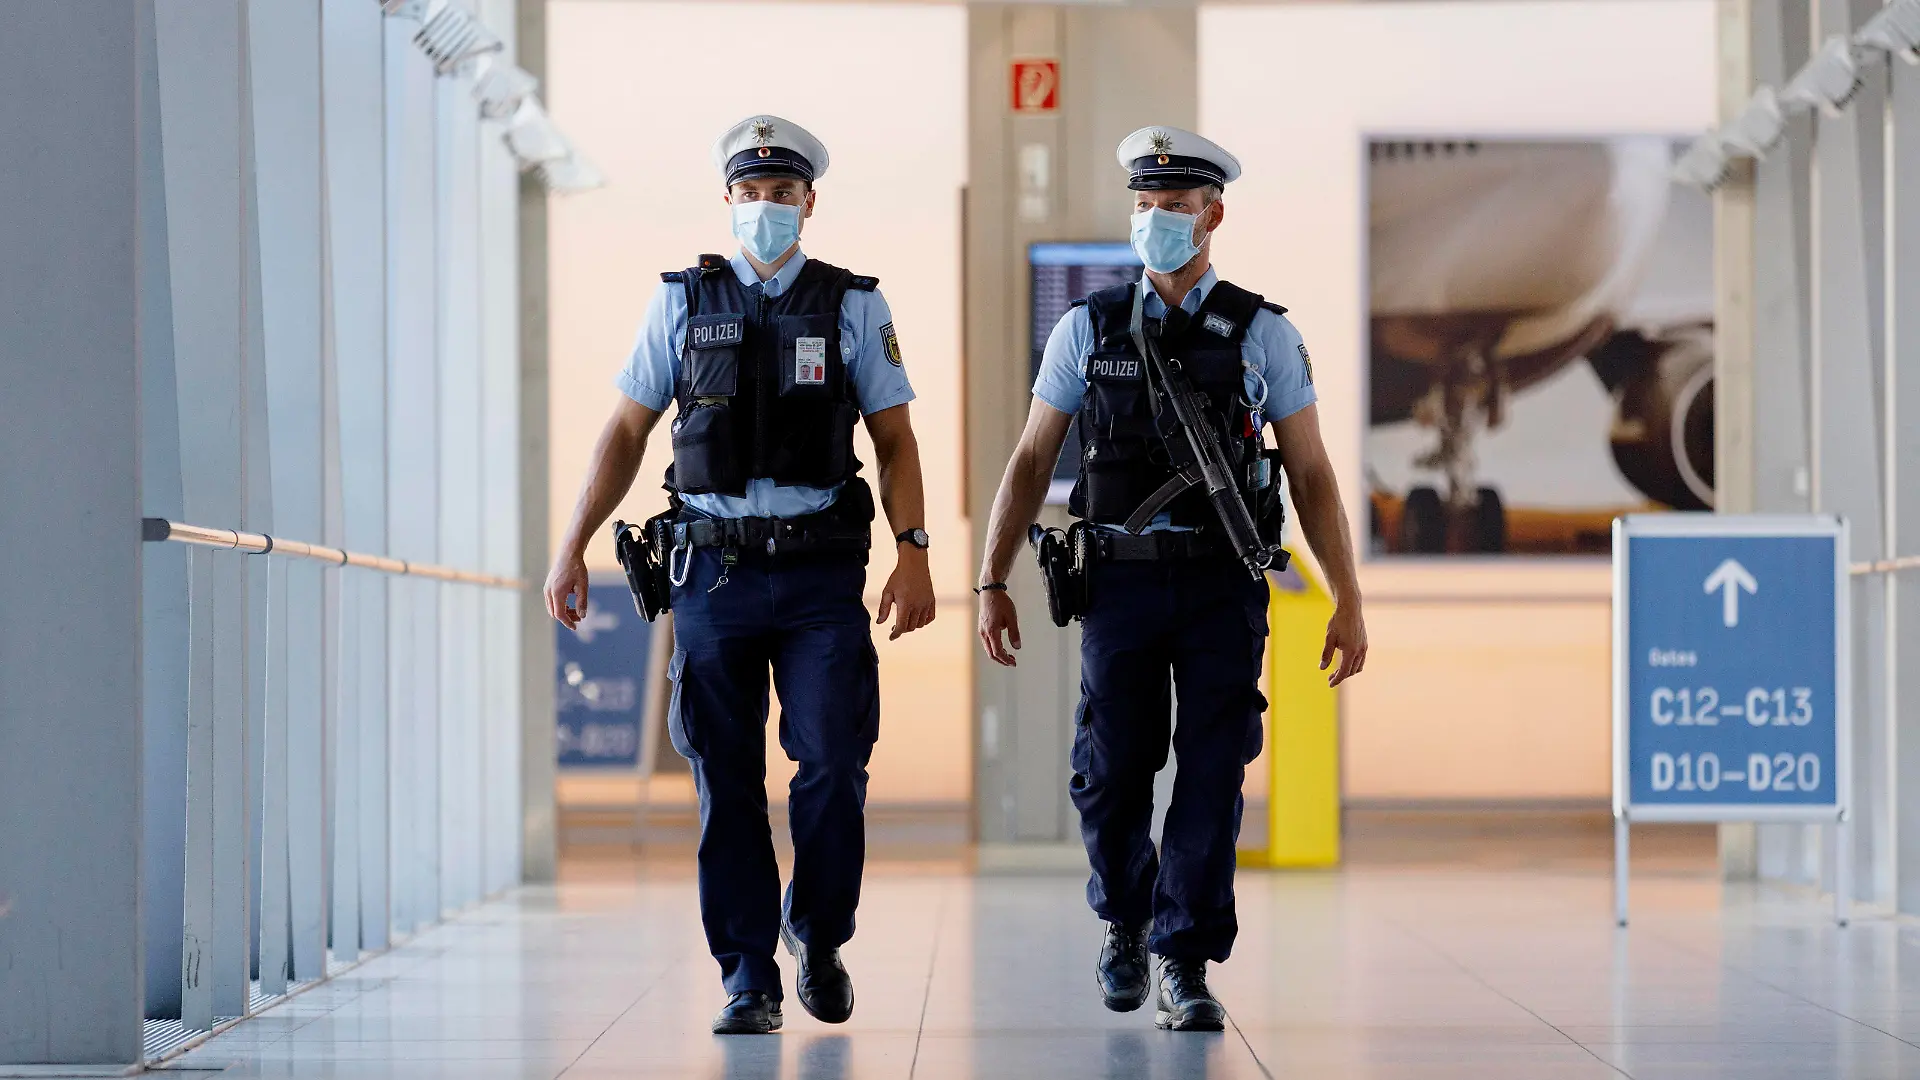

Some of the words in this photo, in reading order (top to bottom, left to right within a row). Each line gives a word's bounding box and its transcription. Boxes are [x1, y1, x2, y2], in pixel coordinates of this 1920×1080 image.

[694, 323, 738, 344] POLIZEI
[1092, 359, 1139, 376] POLIZEI
[1650, 687, 1813, 726] C12-C13
[1651, 752, 1821, 792] D10-D20
